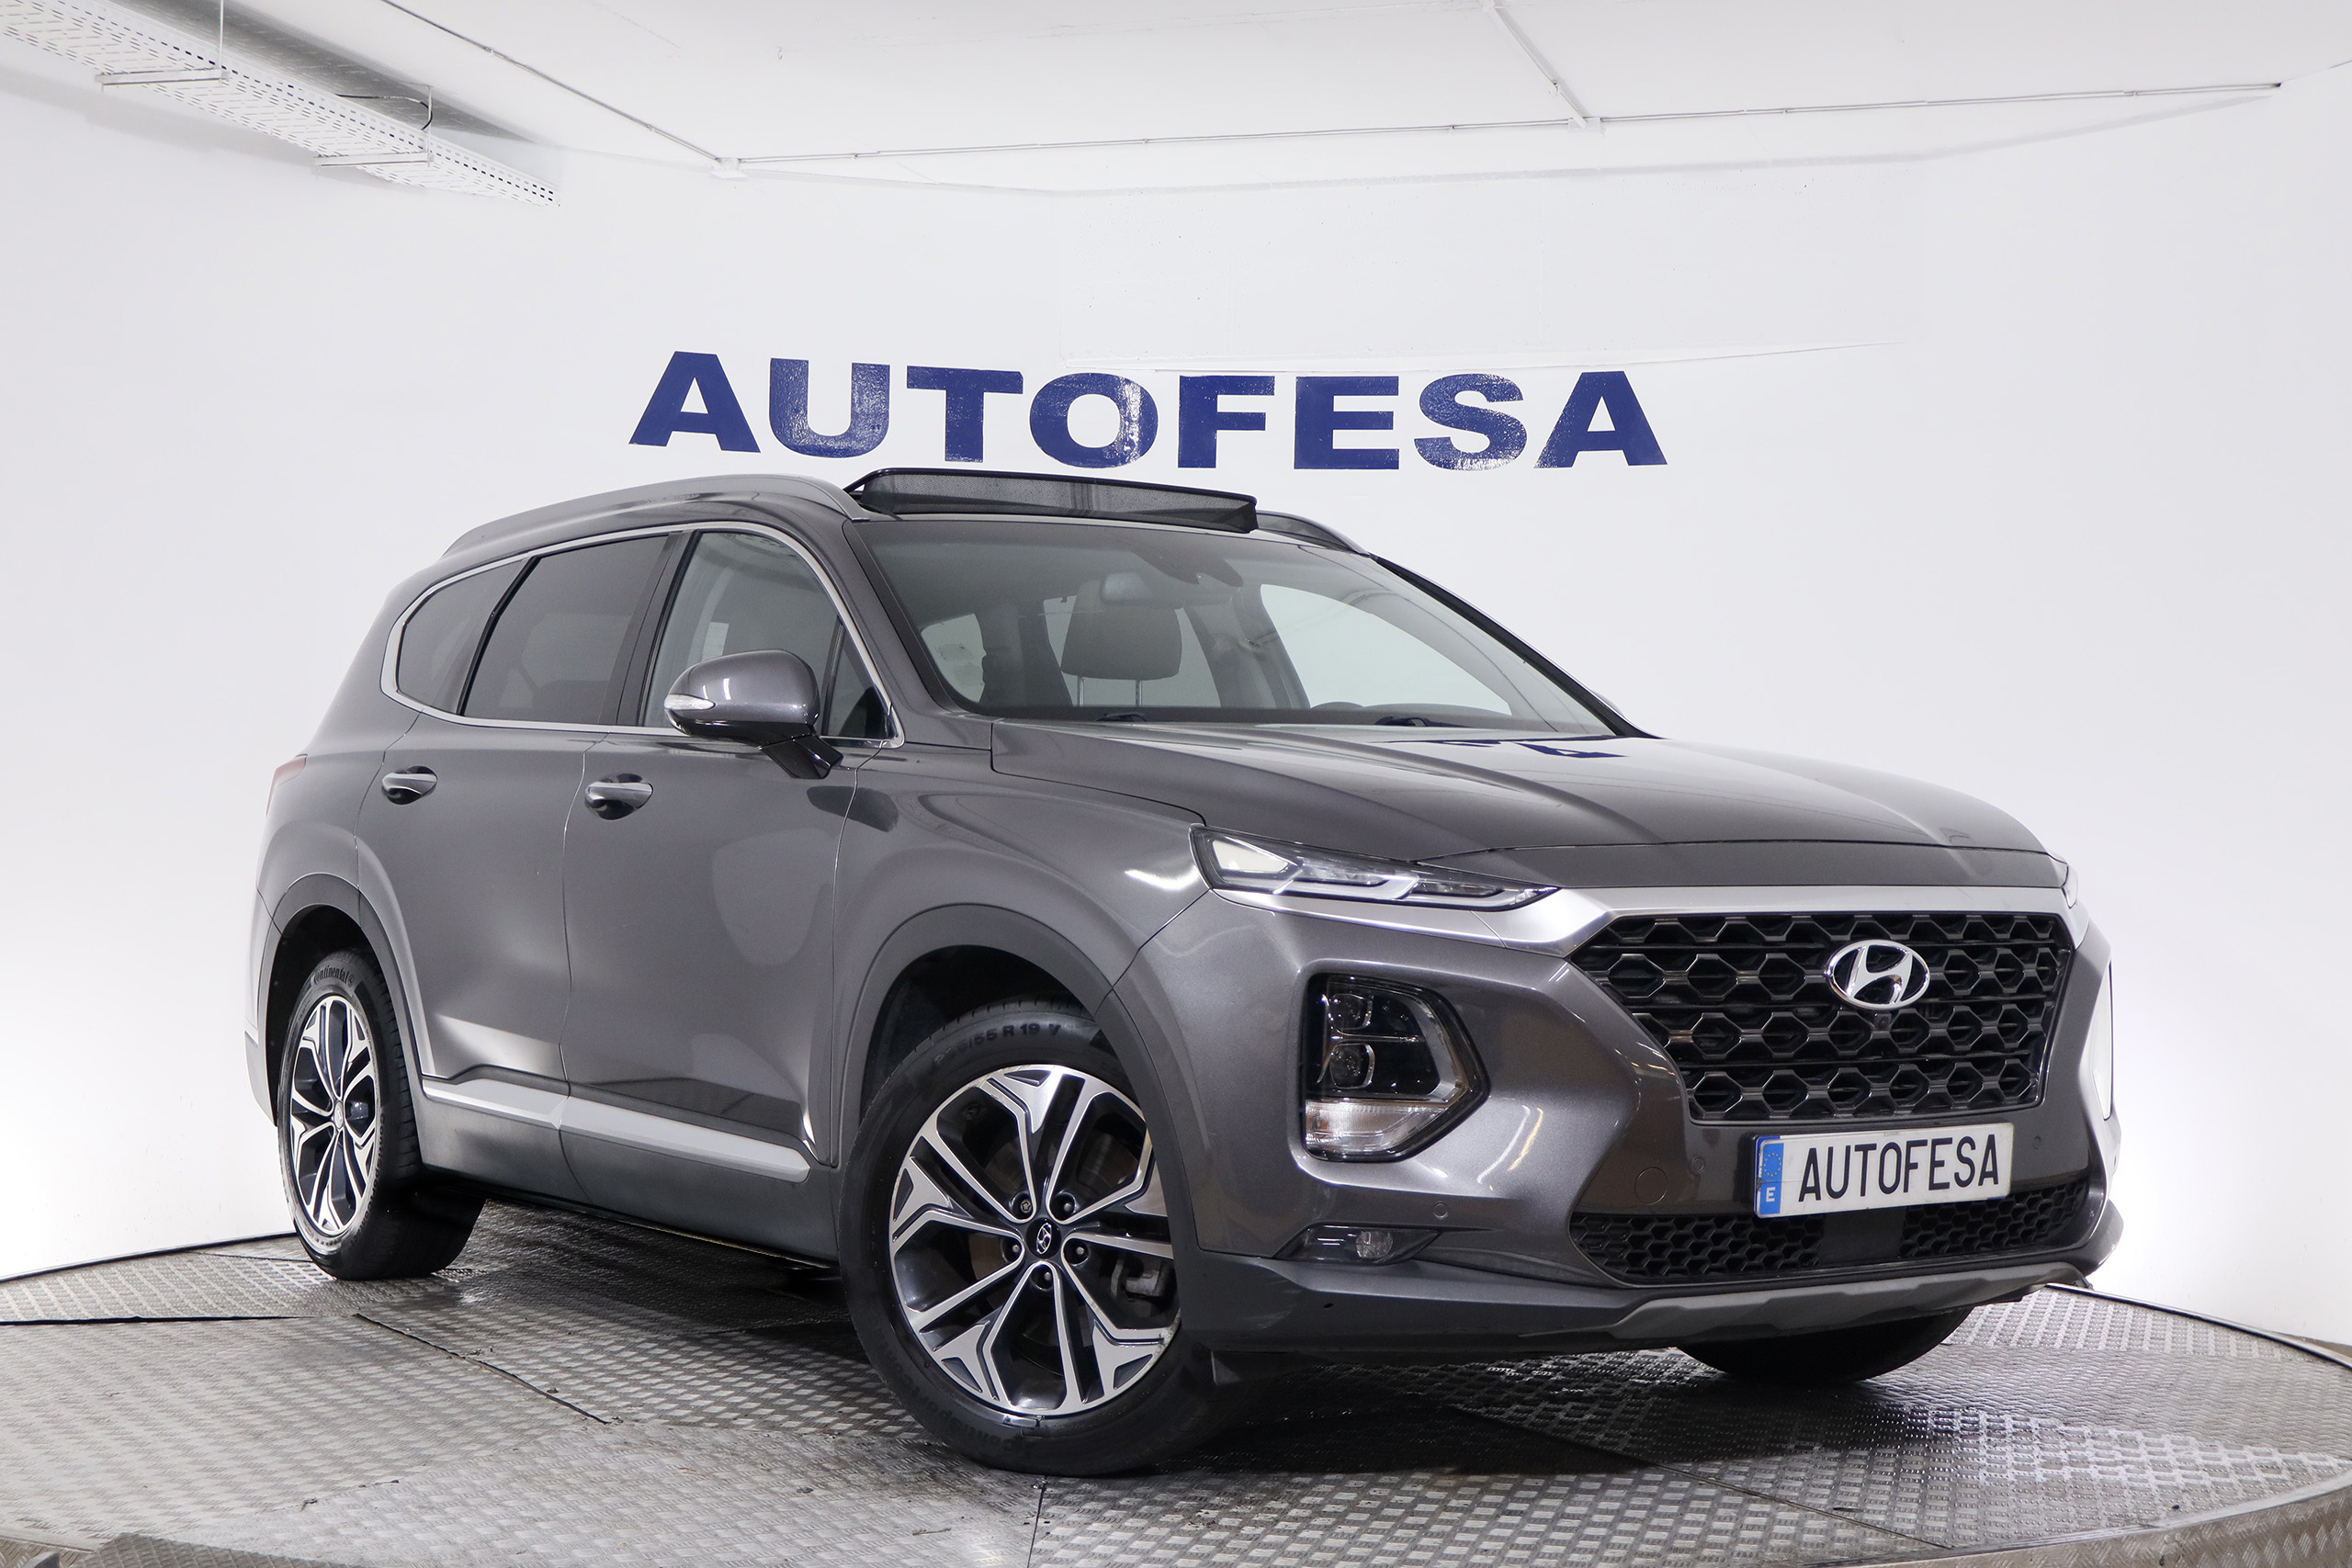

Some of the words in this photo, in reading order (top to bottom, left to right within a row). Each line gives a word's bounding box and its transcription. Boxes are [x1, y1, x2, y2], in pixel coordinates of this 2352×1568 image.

[629, 351, 1668, 469] AUTOFESA
[313, 964, 350, 985] Continental
[1002, 1024, 1015, 1038] R
[1020, 1022, 1041, 1036] 19
[1797, 1134, 2000, 1203] AUTOFESA
[1766, 1186, 1776, 1202] E
